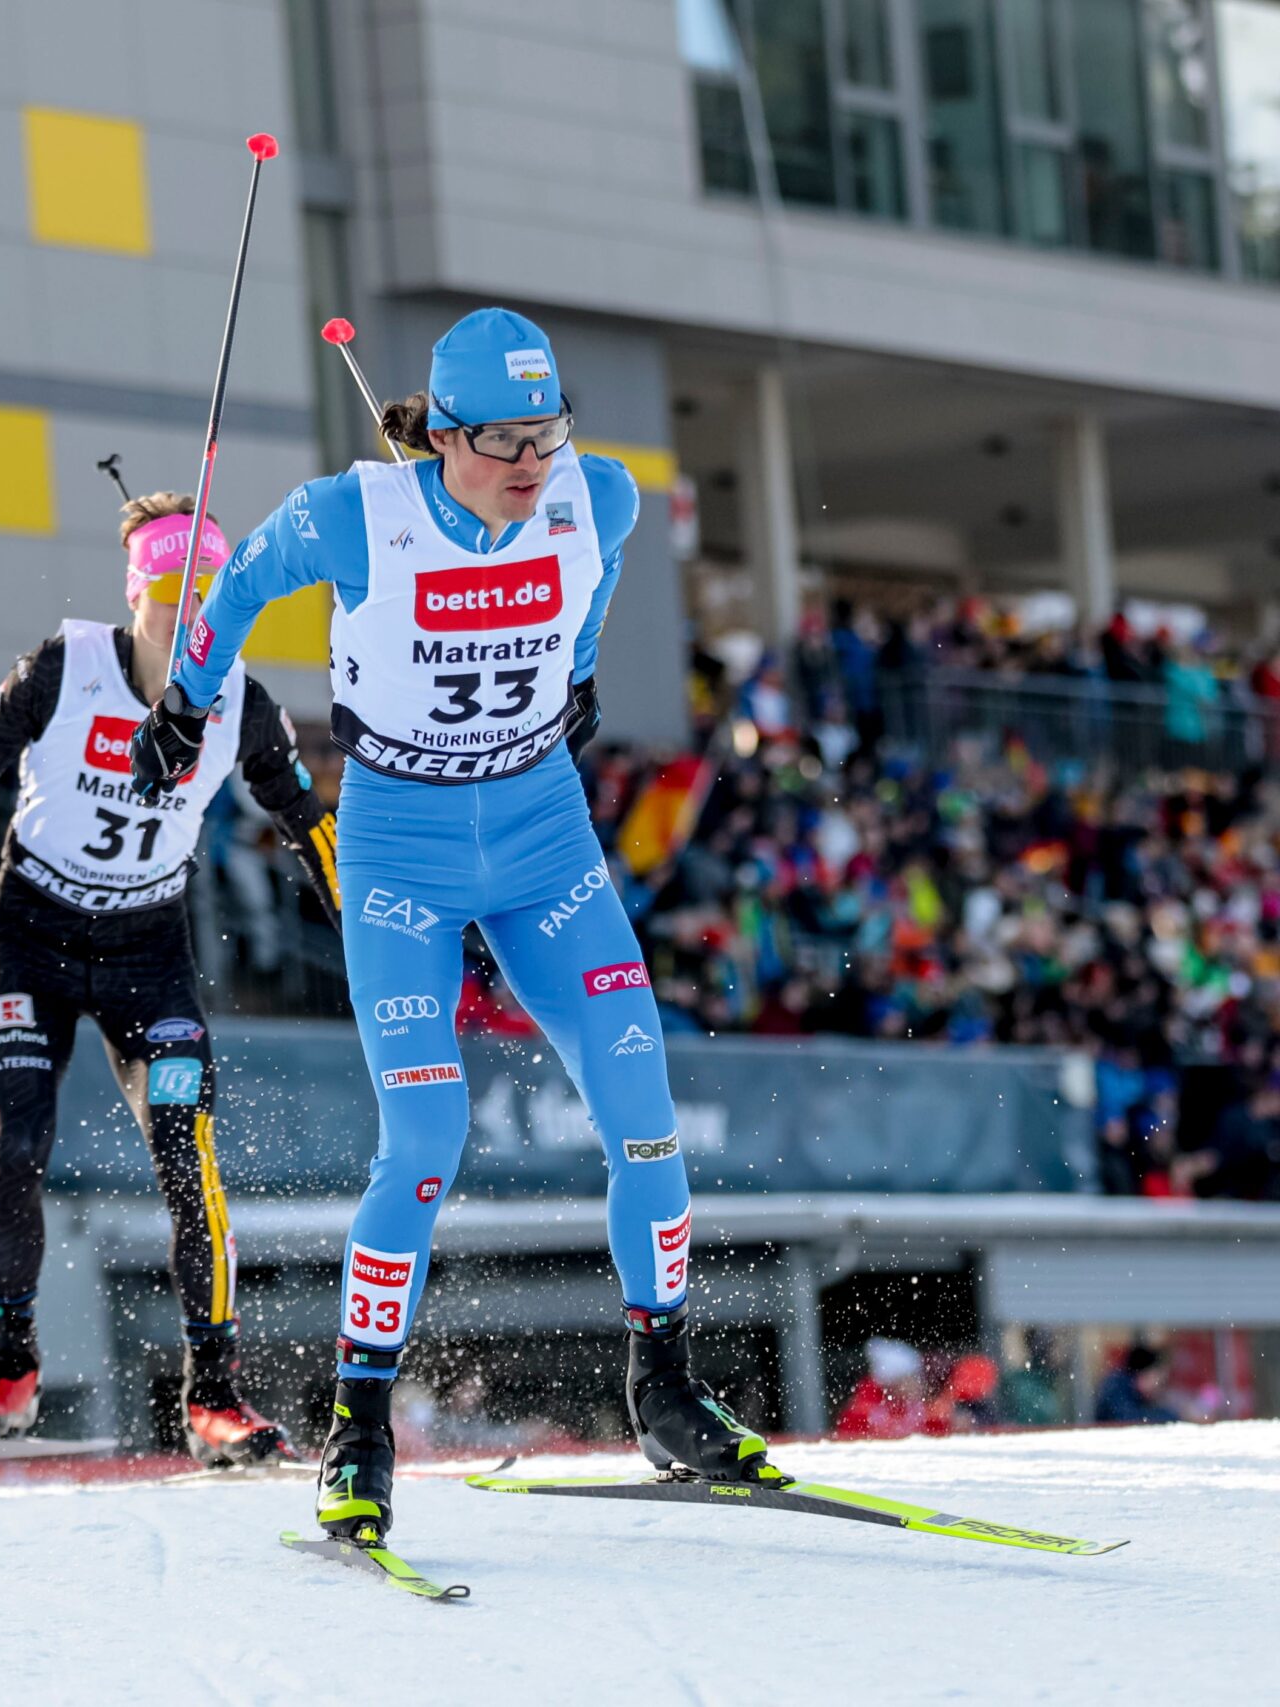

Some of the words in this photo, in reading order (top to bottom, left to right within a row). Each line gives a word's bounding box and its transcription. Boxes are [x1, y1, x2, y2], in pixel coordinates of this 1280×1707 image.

[426, 581, 551, 612] bett1.de
[412, 632, 561, 665] Matratze
[428, 667, 540, 725] 33
[355, 717, 565, 779] SKECHER
[411, 726, 519, 748] THÜRINGEN
[82, 807, 163, 862] 31
[363, 887, 440, 932] EA7
[593, 966, 647, 991] enel
[381, 1025, 409, 1037] Audi
[615, 1043, 654, 1057] AVIO
[396, 1066, 460, 1084] FINSTRAL
[353, 1256, 408, 1282] bett1.de
[350, 1292, 402, 1334] 33
[710, 1485, 752, 1497] FISCHER
[949, 1519, 1080, 1548] FISCHER
